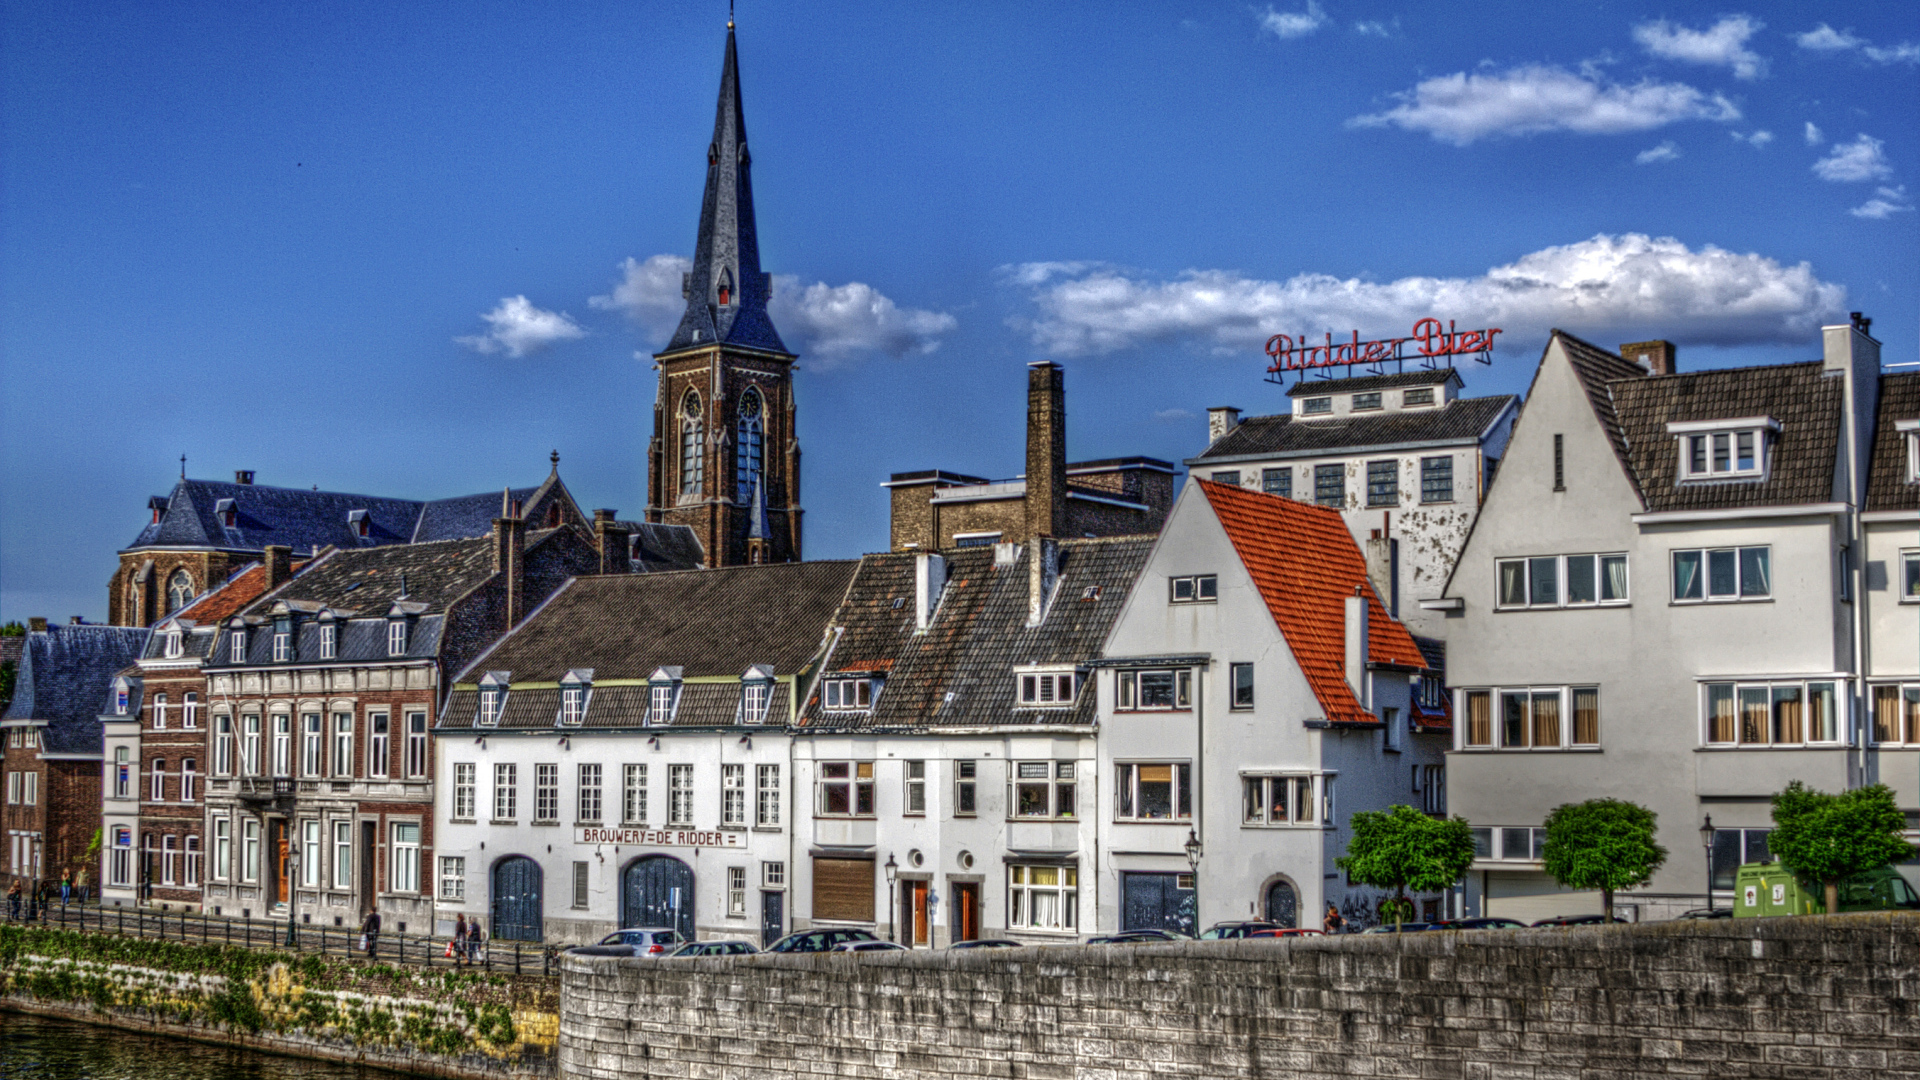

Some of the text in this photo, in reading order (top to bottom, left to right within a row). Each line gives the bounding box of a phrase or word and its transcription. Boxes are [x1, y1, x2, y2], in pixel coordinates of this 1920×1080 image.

[1265, 317, 1503, 372] Ridder Bier
[678, 832, 722, 845] RIDDER
